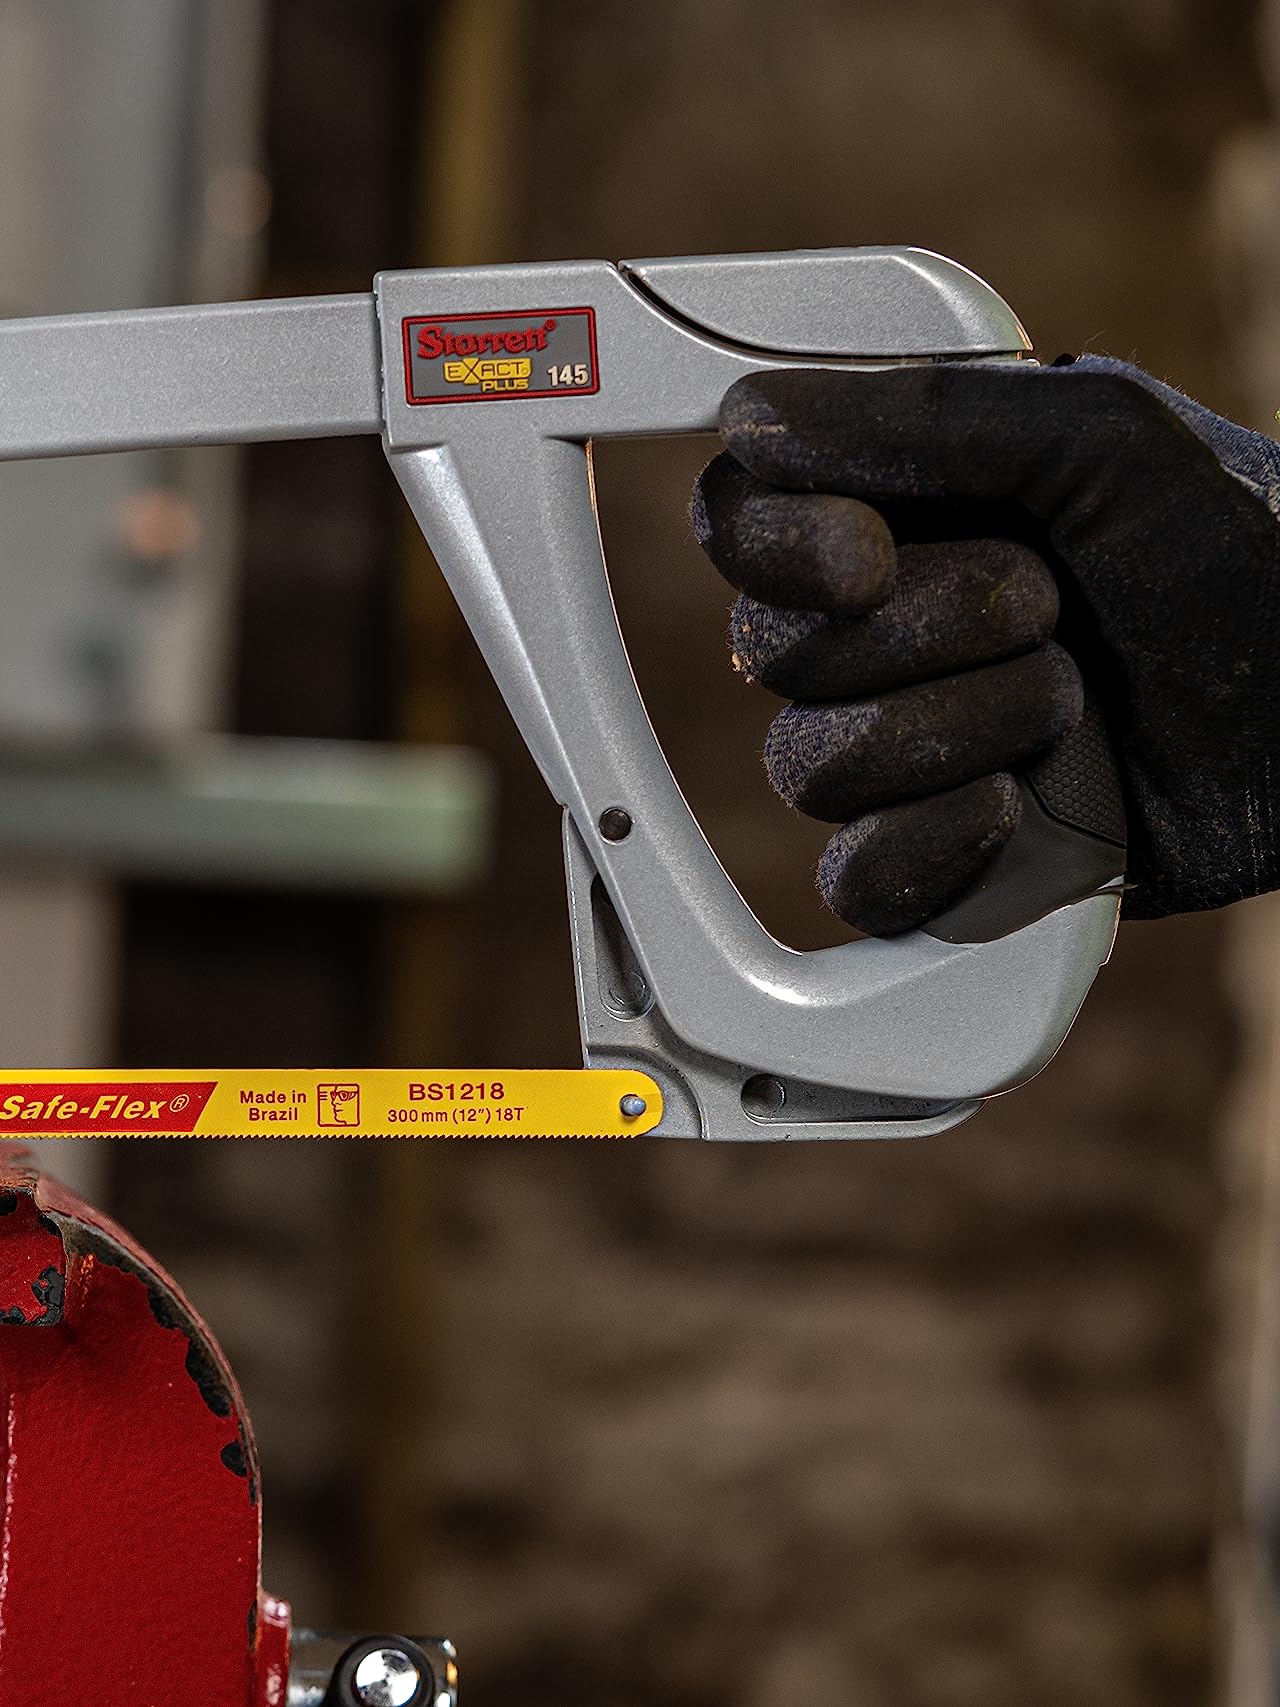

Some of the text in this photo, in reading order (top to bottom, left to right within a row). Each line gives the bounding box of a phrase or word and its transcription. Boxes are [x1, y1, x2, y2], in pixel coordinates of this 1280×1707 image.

[445, 358, 525, 385] EXACT
[547, 363, 590, 388] 145
[481, 379, 530, 393] PLUS
[240, 1090, 307, 1104] Made in
[408, 1083, 505, 1101] BS1218
[248, 1107, 298, 1122] Brazil
[495, 1107, 524, 1122] 18T
